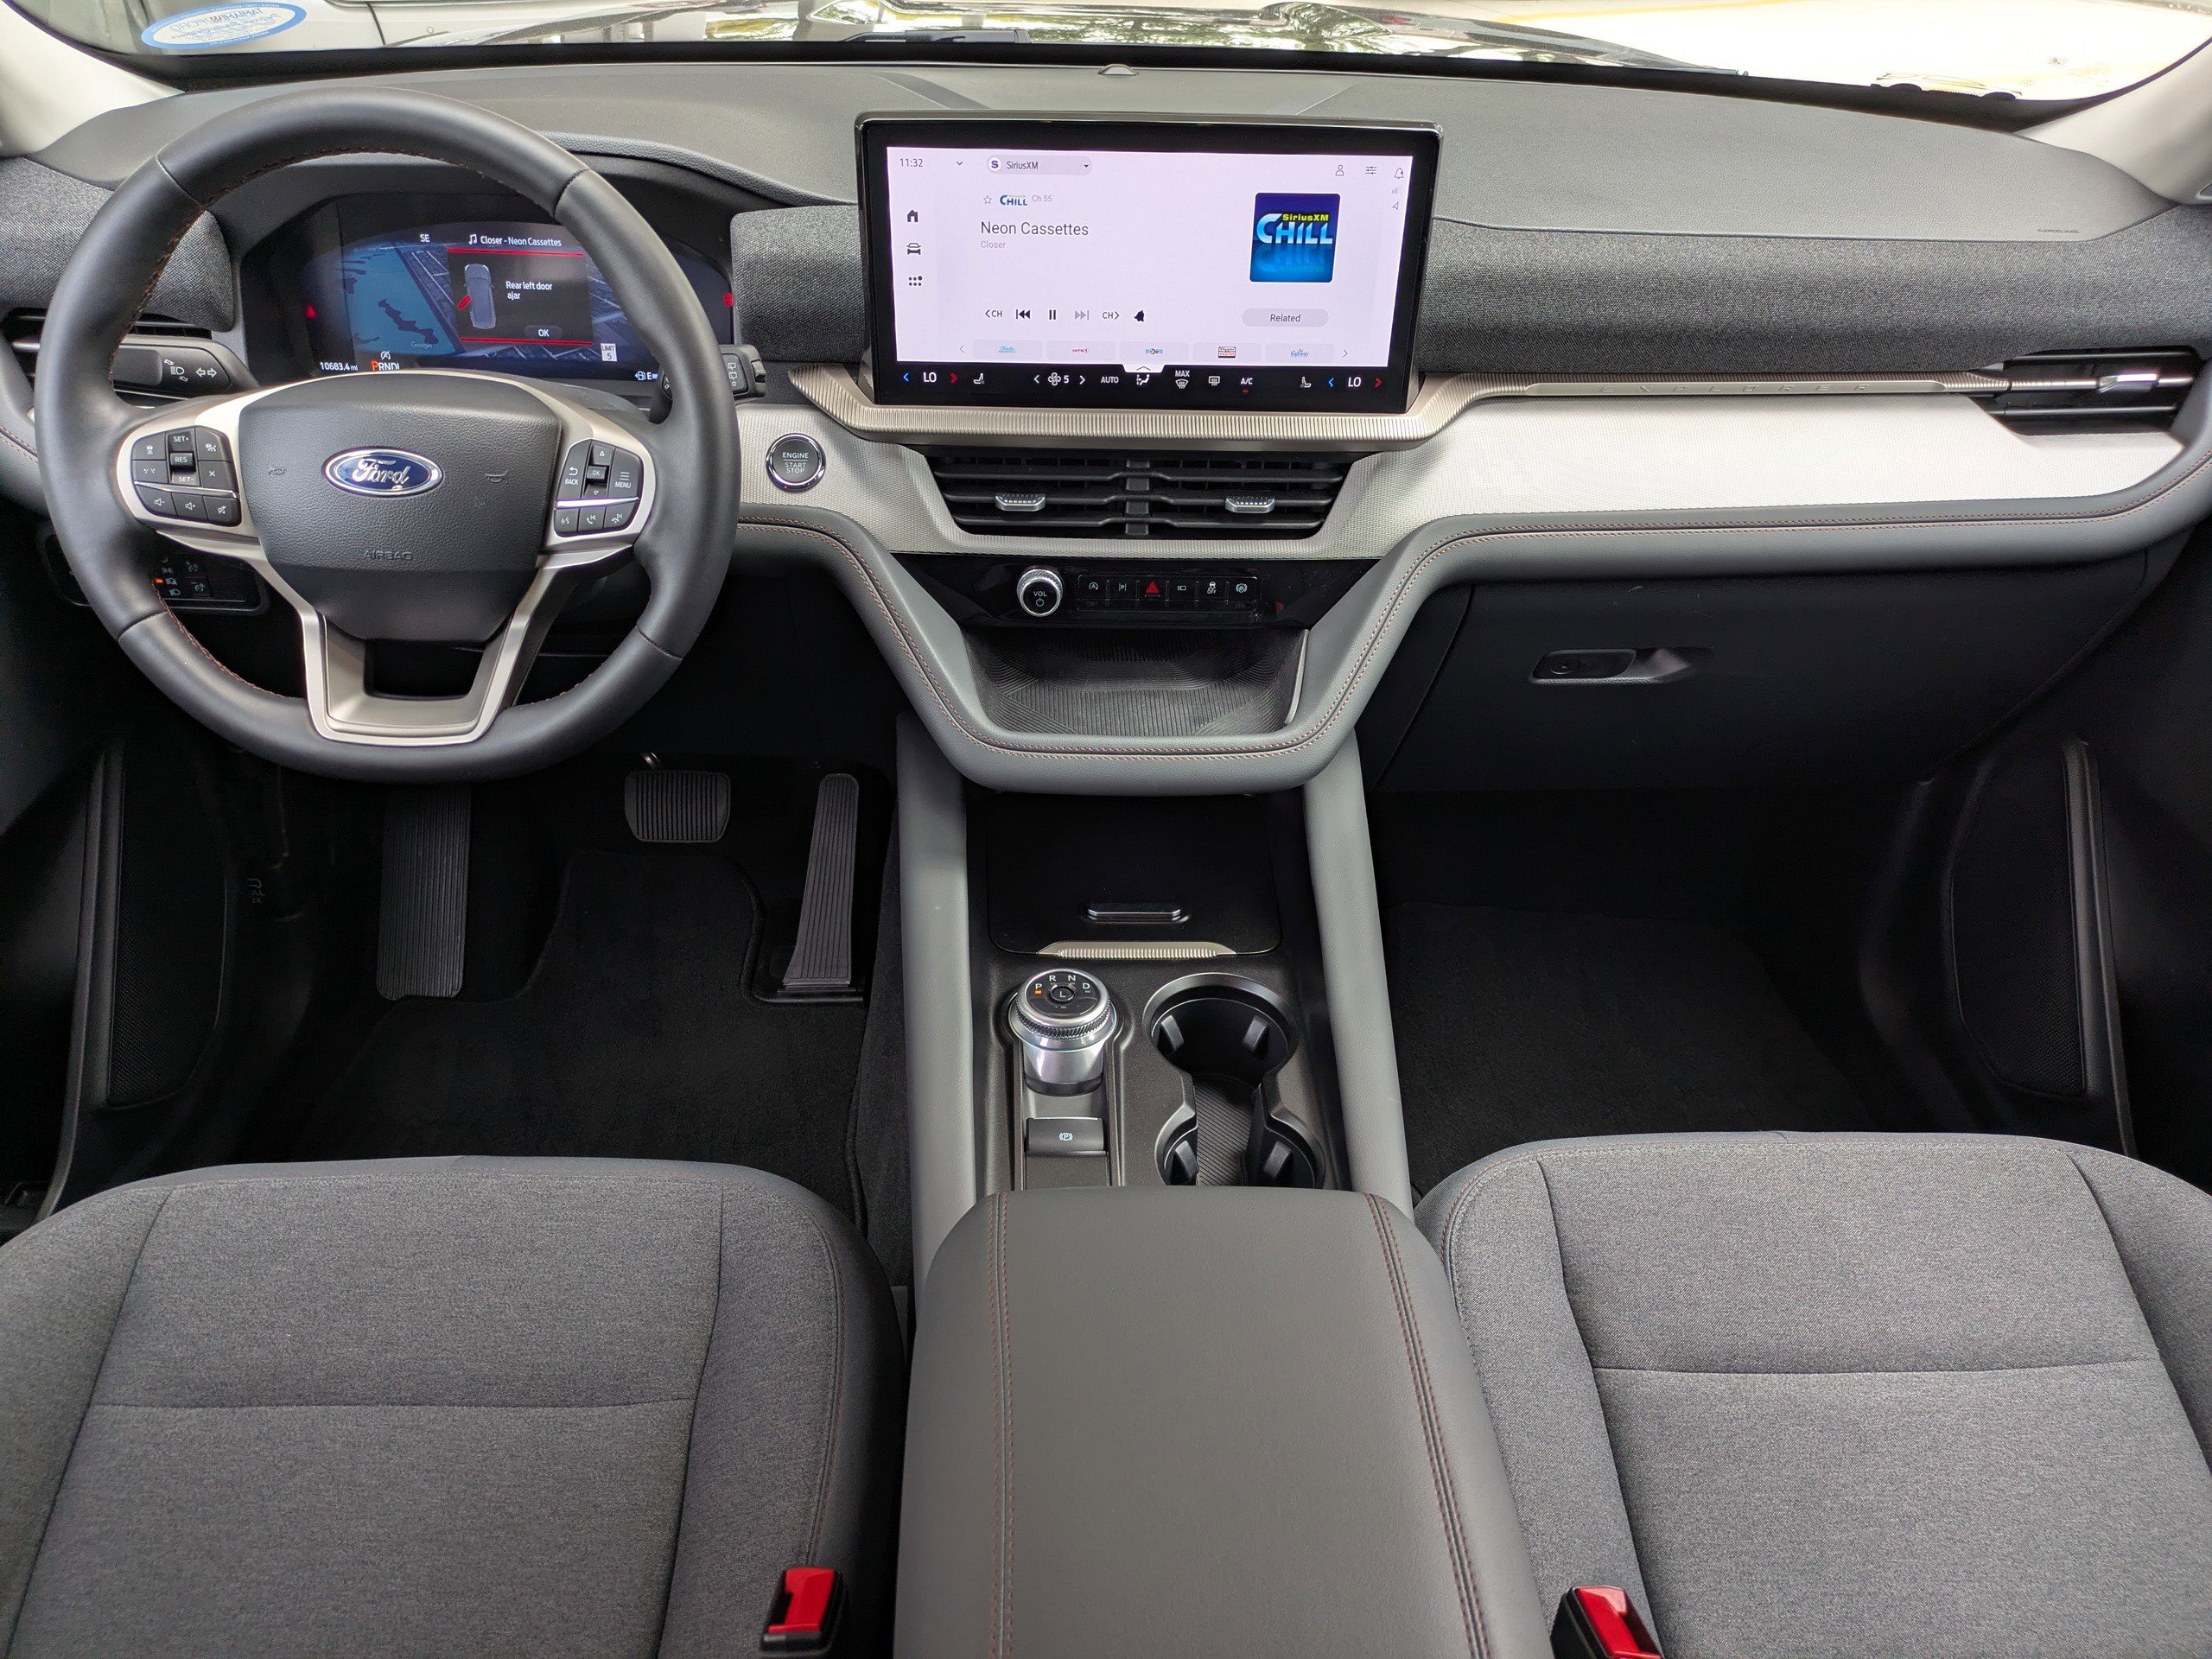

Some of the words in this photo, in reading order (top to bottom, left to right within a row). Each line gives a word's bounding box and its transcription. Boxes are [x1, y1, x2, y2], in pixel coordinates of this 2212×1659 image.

[899, 158, 924, 168] 11:32
[1006, 161, 1039, 170] SiriusXM
[999, 194, 1028, 207] CHILL
[1043, 194, 1052, 203] 55
[980, 220, 1017, 235] Neon
[1020, 221, 1089, 236] Cassettes
[1256, 213, 1333, 245] CHILL
[419, 233, 430, 243] SE
[480, 235, 503, 245] Closer
[507, 236, 527, 245] Neon
[527, 237, 563, 247] Cassettes
[980, 240, 1007, 249] Closer
[505, 280, 522, 289] Rear
[522, 281, 536, 290] left
[536, 282, 553, 290] door
[506, 290, 521, 301] ajar
[991, 309, 1003, 318] CH
[1102, 311, 1114, 320] CH
[1269, 314, 1301, 322] Related
[537, 328, 550, 337] OK
[319, 361, 350, 371] 10683.4
[646, 372, 652, 380] E
[923, 372, 938, 383] LO
[1064, 375, 1070, 385] 5
[1100, 376, 1120, 385] AUTO
[1240, 377, 1253, 385] A/C
[1347, 376, 1362, 387] LO
[1599, 384, 1872, 393] EXPLORER
[352, 458, 411, 484] Ford
[364, 550, 414, 561] AIRBAG
